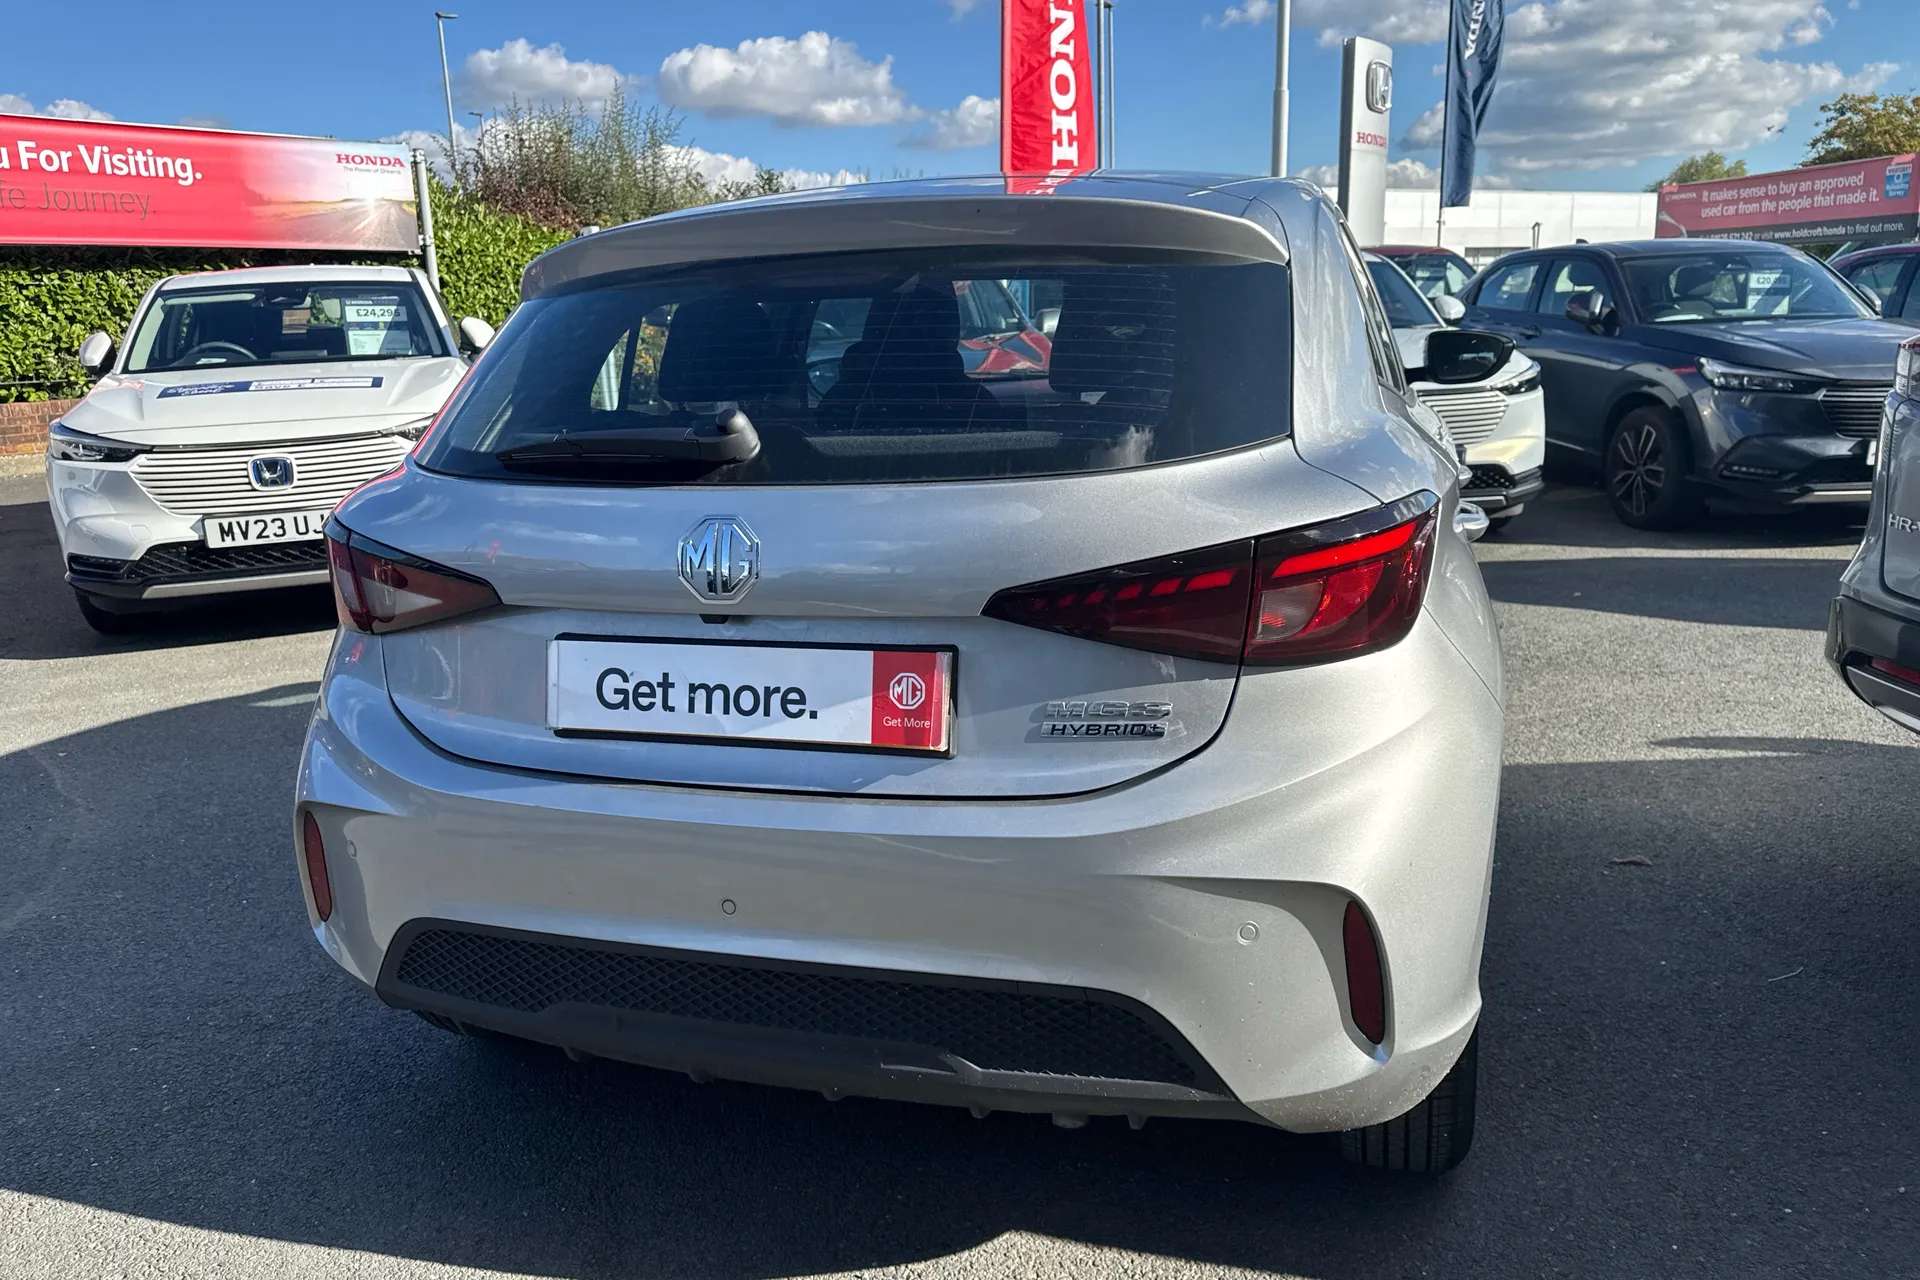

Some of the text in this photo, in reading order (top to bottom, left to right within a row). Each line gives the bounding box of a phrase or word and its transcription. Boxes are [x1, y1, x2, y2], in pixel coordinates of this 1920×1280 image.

[1050, 0, 1078, 166] HON
[17, 140, 72, 172] For
[77, 144, 203, 186] Visiting.
[336, 154, 406, 168] HONDA
[38, 181, 157, 220] Journey.
[1702, 171, 1864, 202] It makes sense to buy an approved
[1701, 187, 1879, 218] used car from the people that made it.
[1847, 225, 1855, 234] to
[1856, 223, 1869, 233] find
[1870, 222, 1882, 232] out
[218, 517, 287, 543] MV23
[1889, 512, 1920, 533] HR-
[686, 523, 753, 596] MG
[596, 667, 818, 720] Get more.
[894, 676, 922, 706] MG
[883, 716, 931, 729] Get More
[1050, 723, 1166, 737] HYBRID+
